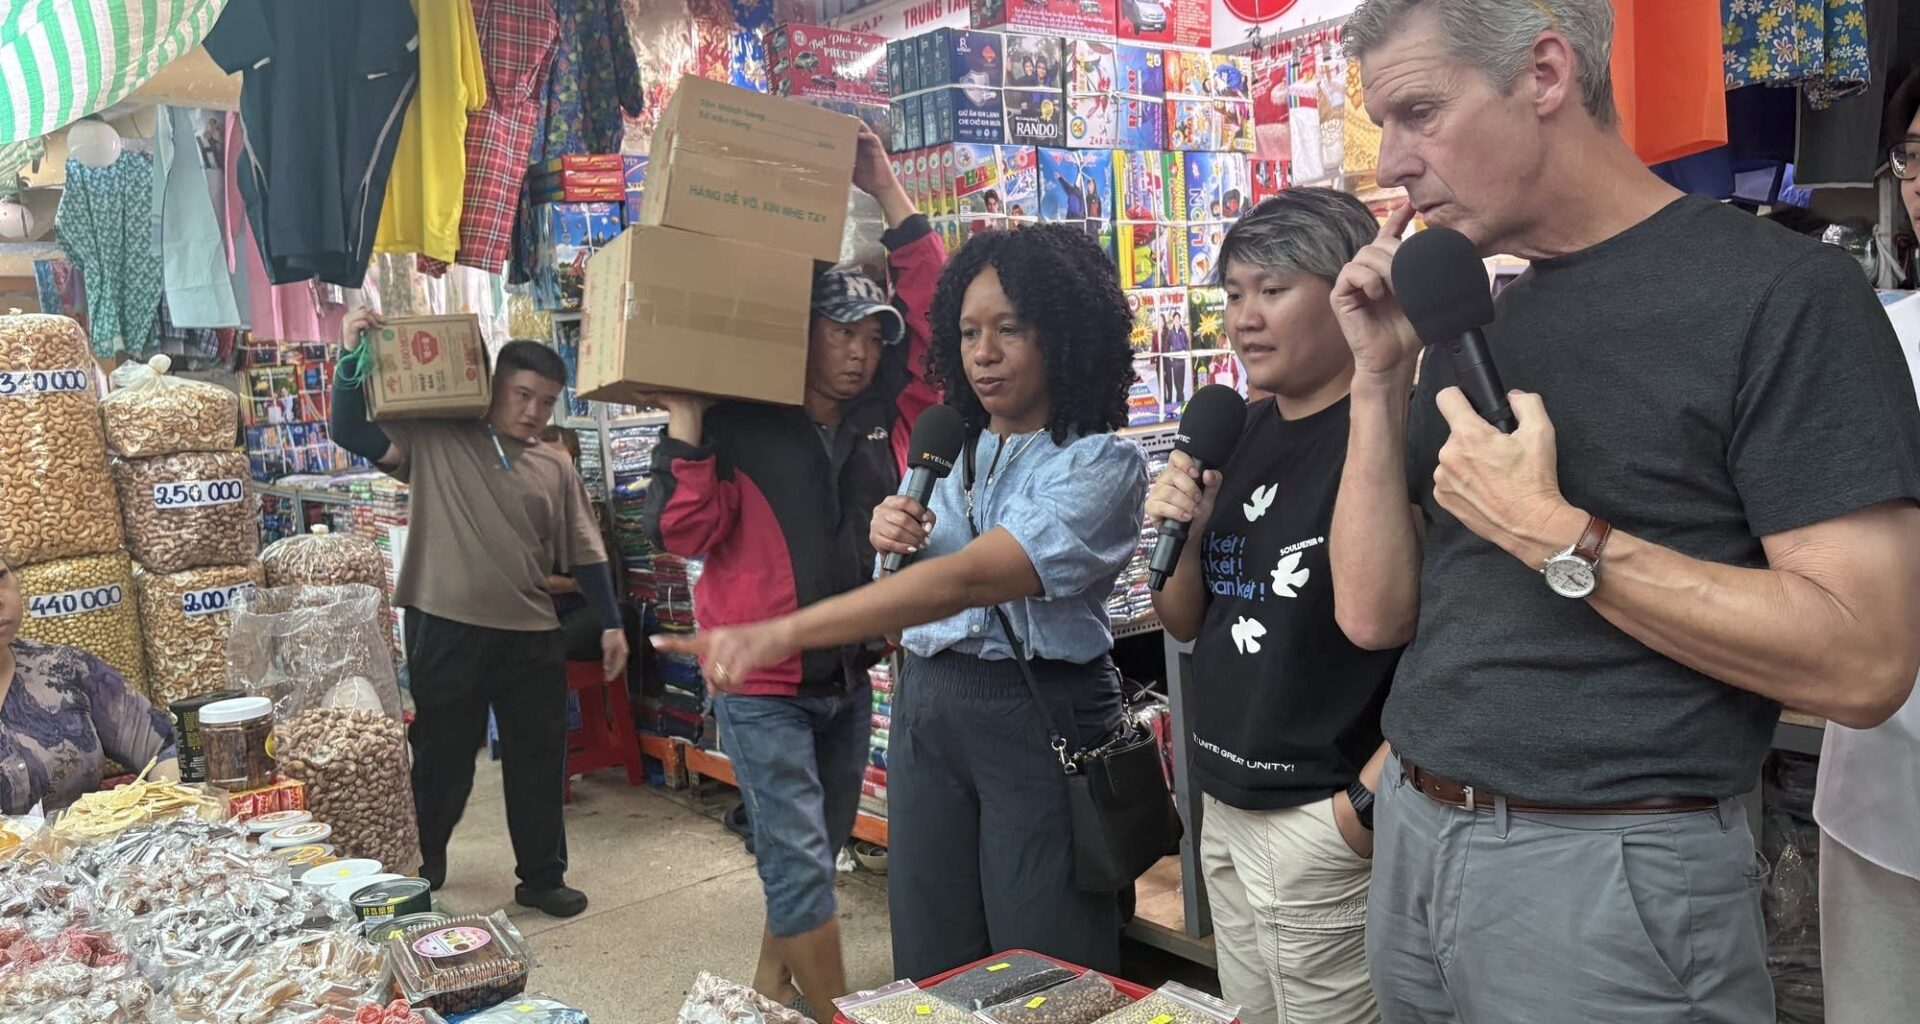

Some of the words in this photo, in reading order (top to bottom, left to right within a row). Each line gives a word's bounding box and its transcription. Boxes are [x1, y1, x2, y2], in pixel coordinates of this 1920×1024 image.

[903, 0, 942, 29] TRUNG
[1016, 122, 1055, 137] RANDO
[51, 370, 87, 390] 000
[31, 598, 77, 615] 440
[81, 585, 122, 609] 000
[1220, 749, 1245, 765] GREAT
[1246, 760, 1295, 772] UNITY!
